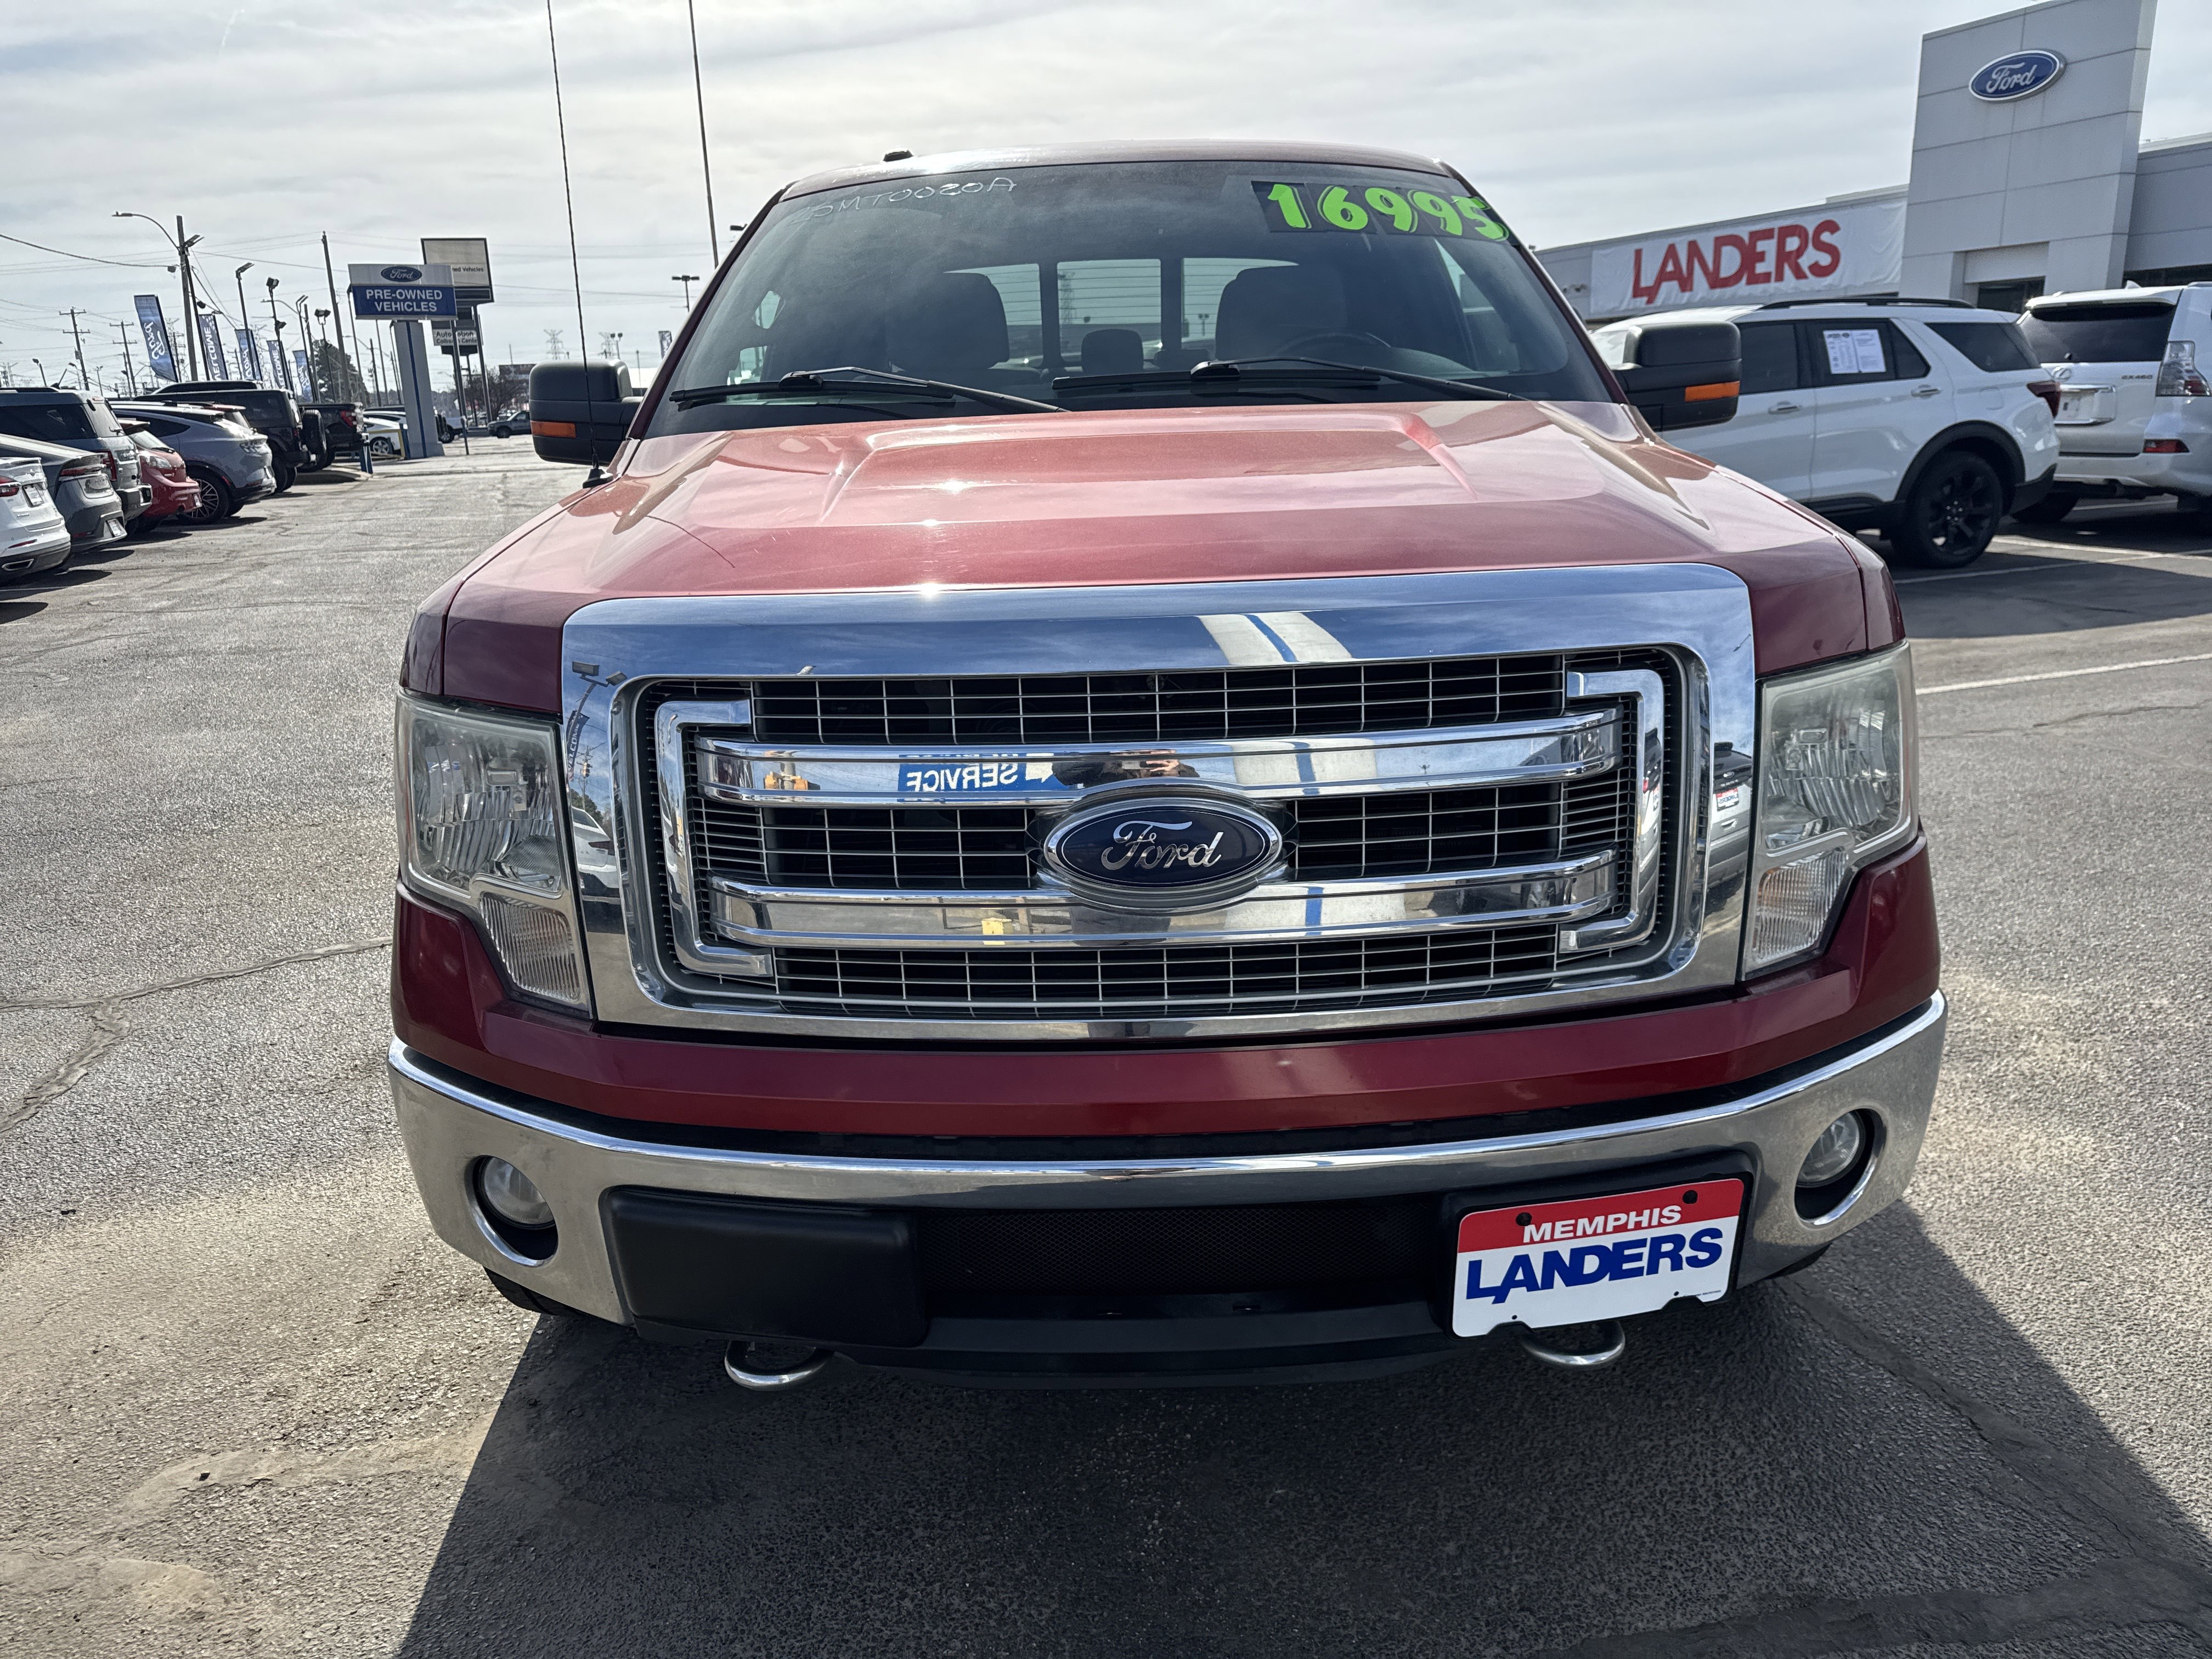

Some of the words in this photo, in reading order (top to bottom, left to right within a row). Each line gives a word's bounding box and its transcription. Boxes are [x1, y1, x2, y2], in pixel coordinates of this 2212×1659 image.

[1985, 61, 2038, 93] Ford
[1267, 184, 1510, 241] 16995
[390, 268, 414, 279] Ford
[1632, 219, 1841, 304] LANDERS
[366, 289, 443, 300] PRE-OWNED
[375, 301, 437, 312] VEHICLES
[1101, 820, 1224, 870] Ford
[1522, 1205, 1682, 1244] MEMPHIS
[1466, 1227, 1723, 1305] LANDERS
